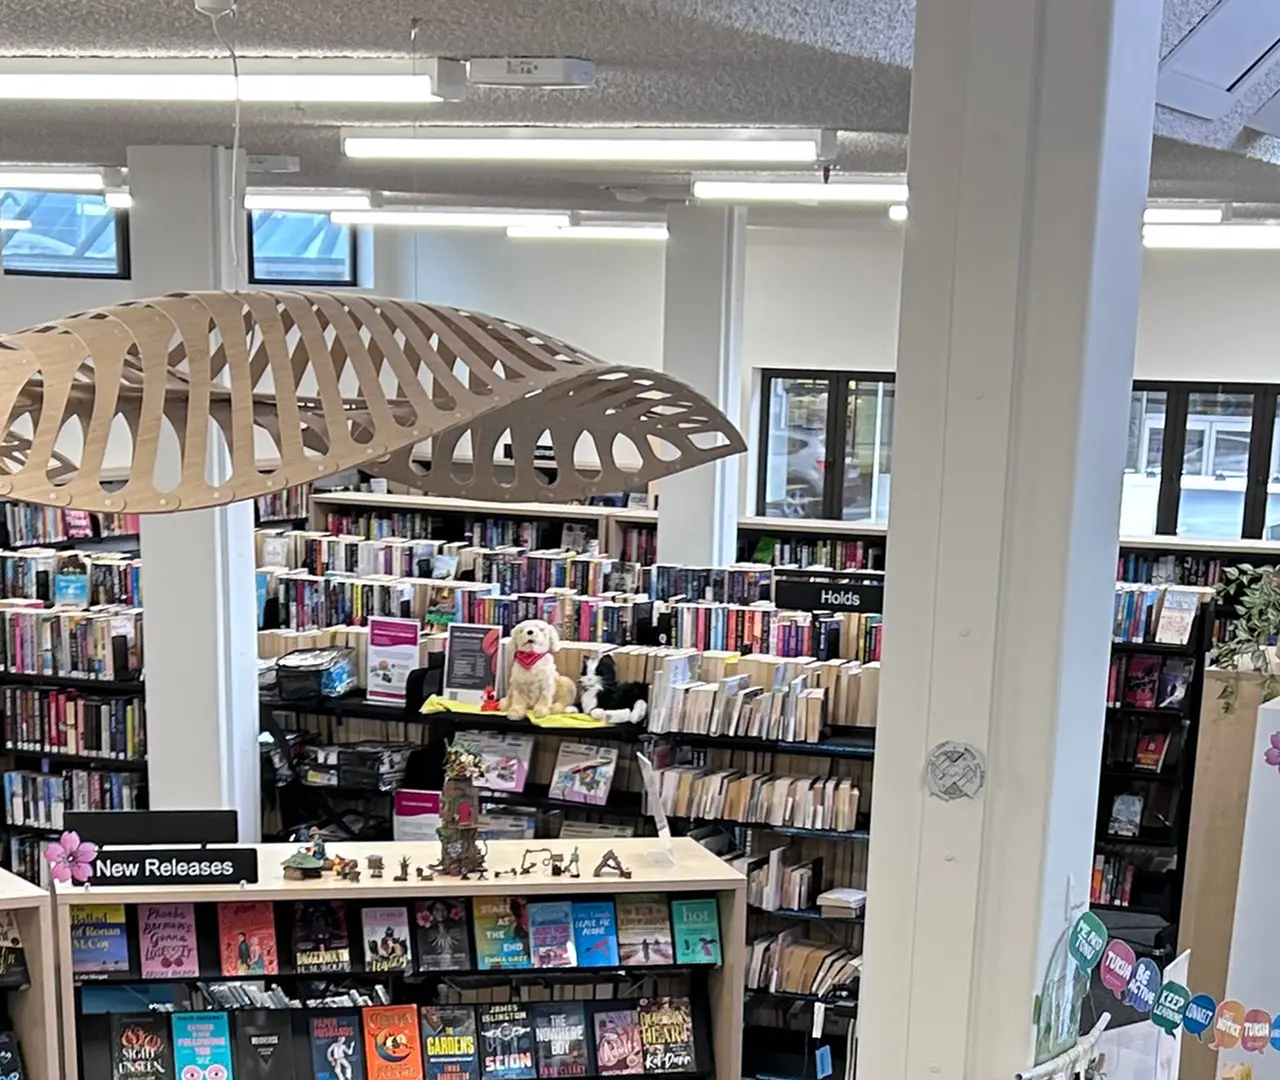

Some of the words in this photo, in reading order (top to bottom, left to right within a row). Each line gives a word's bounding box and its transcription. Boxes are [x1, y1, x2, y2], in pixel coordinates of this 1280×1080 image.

[821, 589, 860, 605] Holds
[96, 859, 139, 877] New
[145, 858, 233, 877] Releases
[485, 931, 505, 940] THE
[503, 943, 524, 952] END
[1136, 963, 1151, 985] BE
[1128, 979, 1155, 1005] ACTIVE
[1160, 990, 1184, 1011] KEEP
[482, 1012, 527, 1022] ISLINGTON
[489, 1004, 518, 1014] JAMES
[549, 1014, 567, 1027] THE
[536, 1026, 584, 1042] NOWHERE
[427, 1036, 475, 1055] GARDENS
[550, 1040, 570, 1055] BOY
[485, 1052, 532, 1071] SCION
